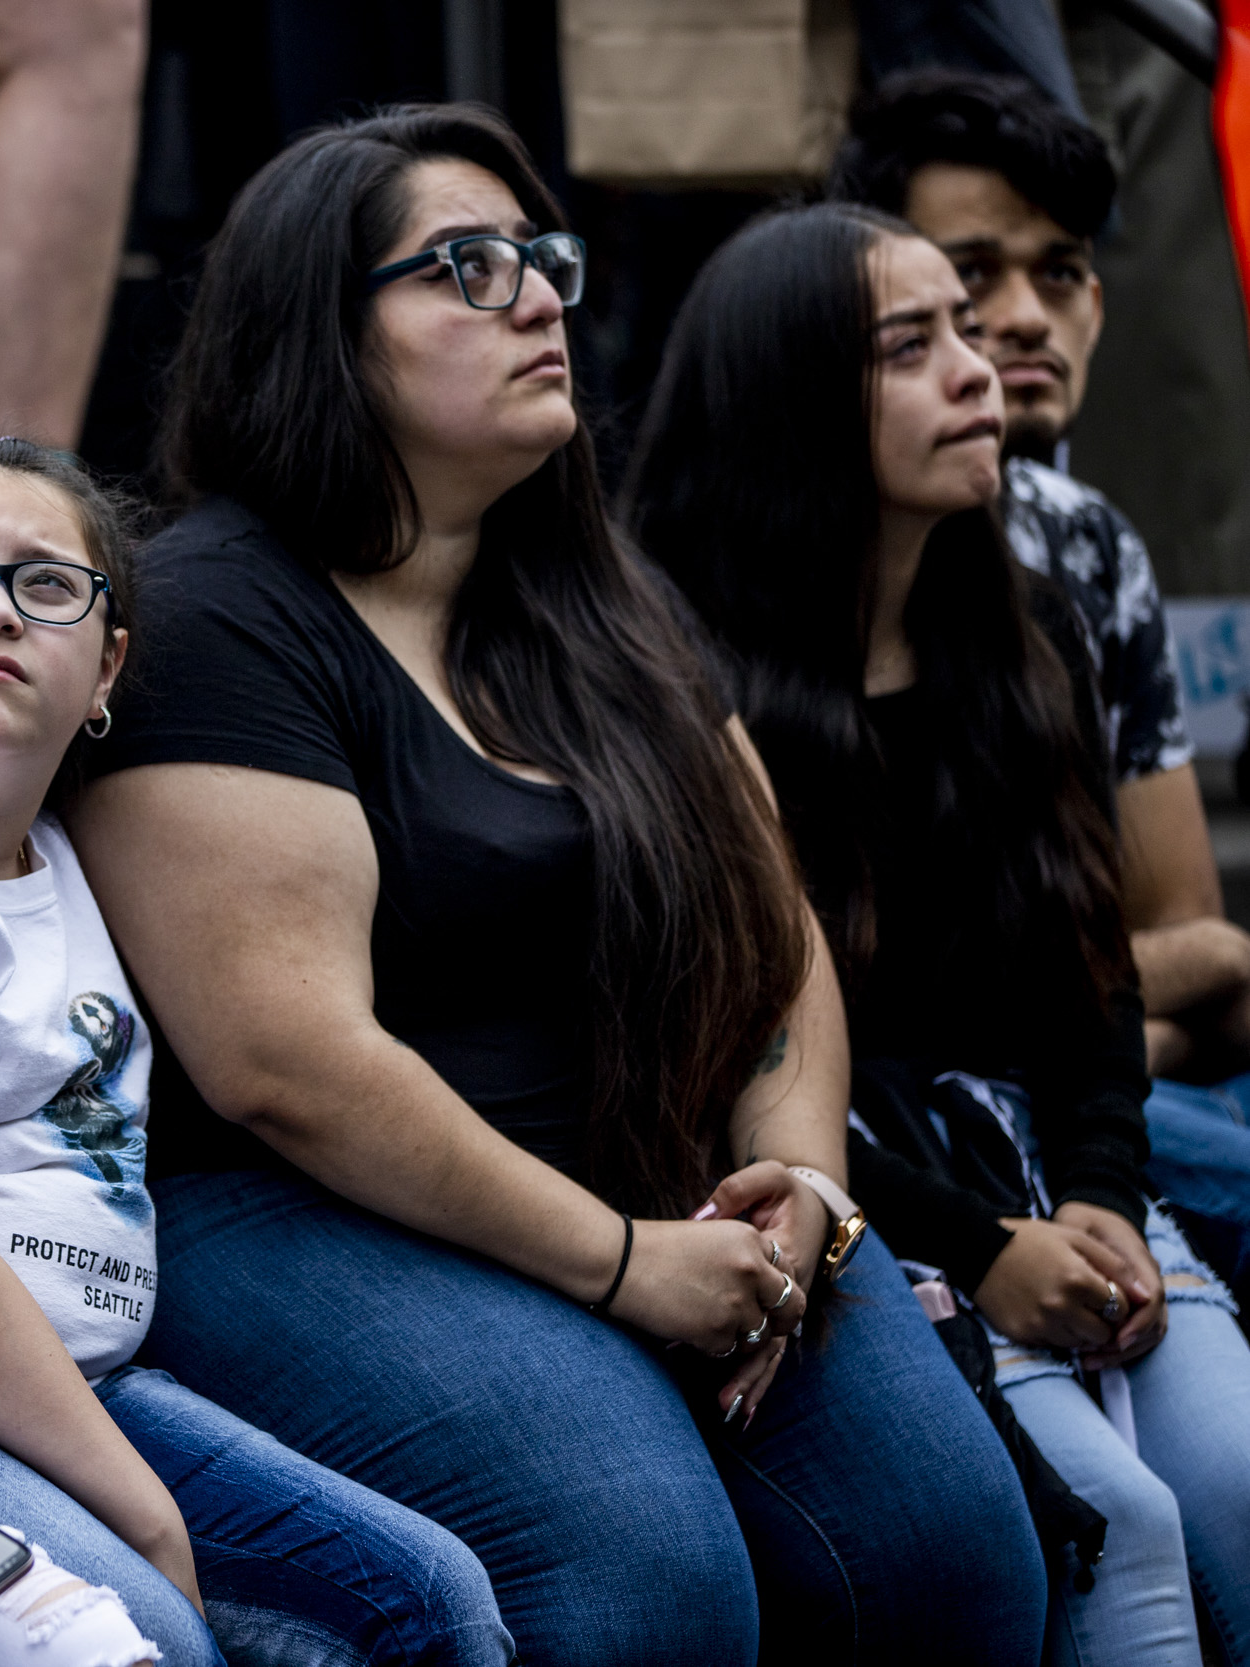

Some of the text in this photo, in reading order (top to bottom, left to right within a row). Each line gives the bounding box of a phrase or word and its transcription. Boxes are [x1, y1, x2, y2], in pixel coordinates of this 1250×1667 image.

[10, 1233, 99, 1272] PROTECT
[99, 1256, 131, 1283] AND
[84, 1285, 143, 1322] SEATTLE
